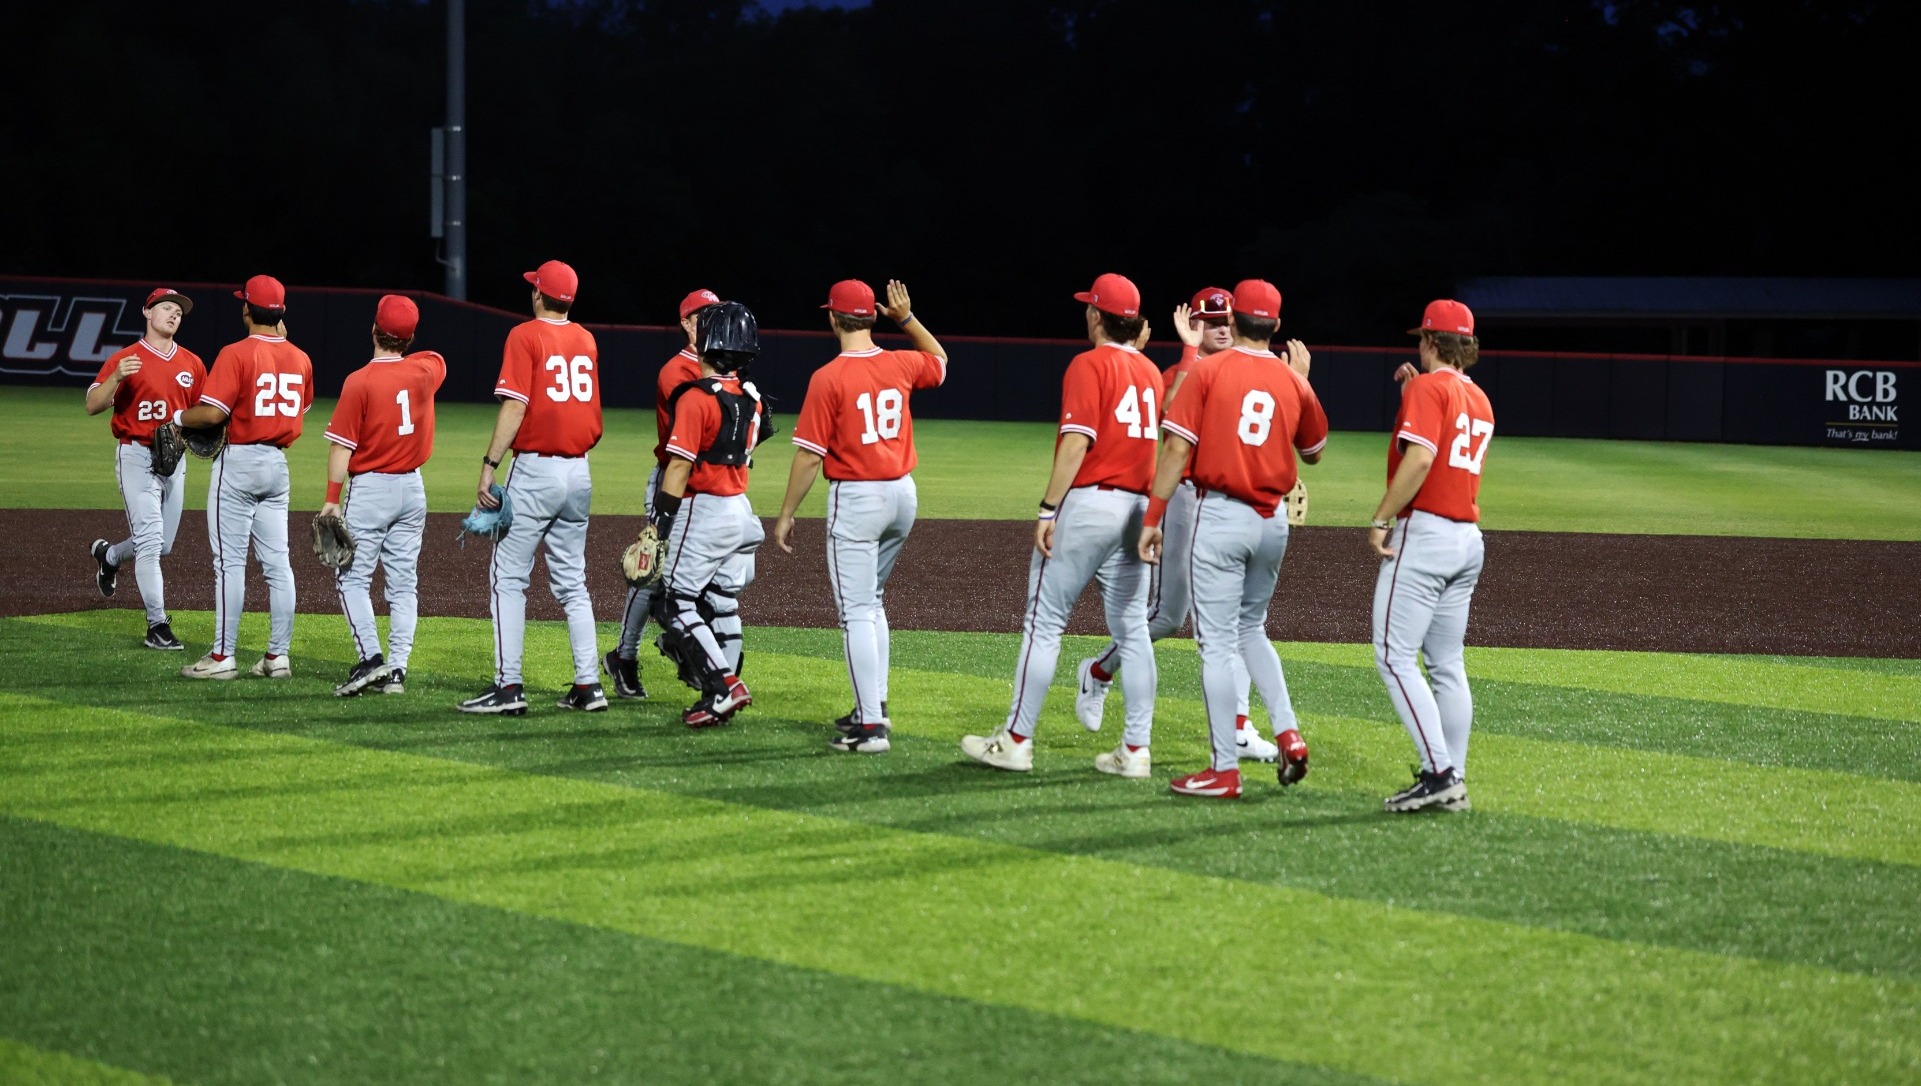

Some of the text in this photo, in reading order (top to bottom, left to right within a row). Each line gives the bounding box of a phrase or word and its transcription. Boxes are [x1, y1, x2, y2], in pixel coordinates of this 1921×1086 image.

[0, 303, 132, 367] LL
[254, 372, 303, 418] 25
[545, 355, 594, 402] 36
[1825, 369, 1897, 402] RCB
[138, 400, 167, 421] 23
[396, 389, 415, 436] 1
[856, 388, 903, 445] 18
[1114, 384, 1158, 441] 41
[1237, 389, 1276, 447] 8
[1849, 404, 1898, 421] BANK
[1448, 412, 1495, 476] 27
[1826, 428, 1898, 441] That's my bank!
